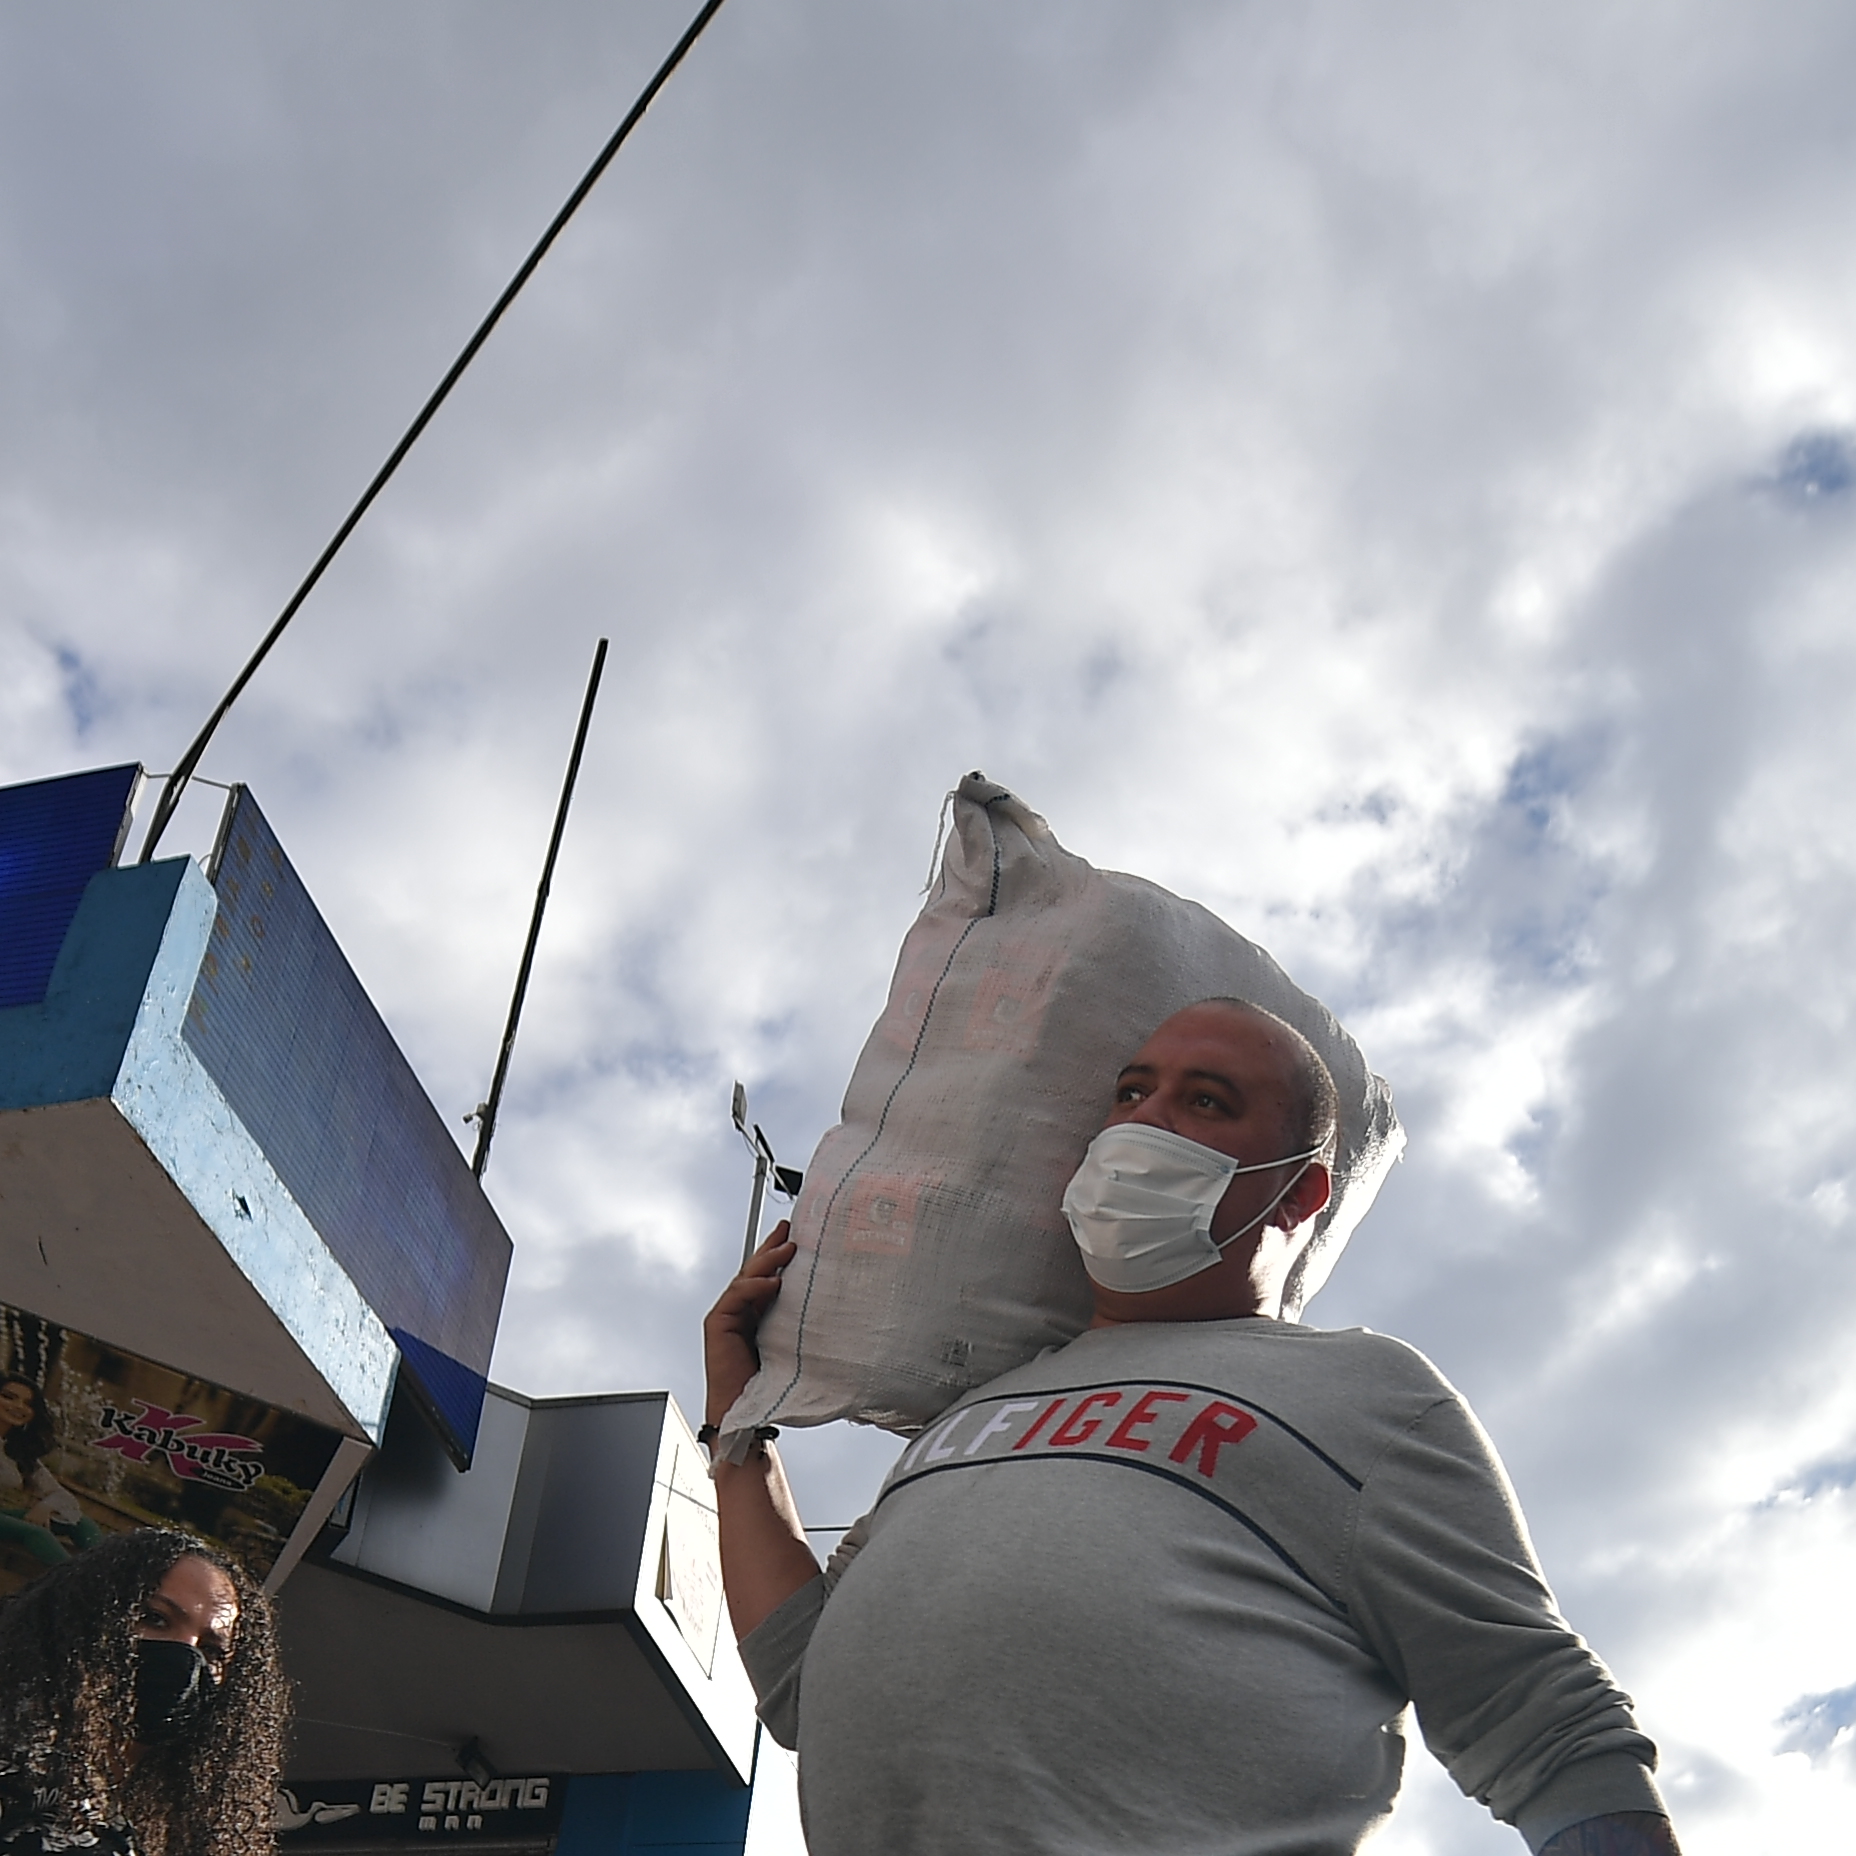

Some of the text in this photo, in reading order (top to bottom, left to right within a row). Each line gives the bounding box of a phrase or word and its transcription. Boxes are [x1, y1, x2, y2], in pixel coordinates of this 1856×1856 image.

[101, 1406, 263, 1487] Kabuky
[903, 1391, 1258, 1478] ILFIGER
[369, 1777, 550, 1814] BE STRONG
